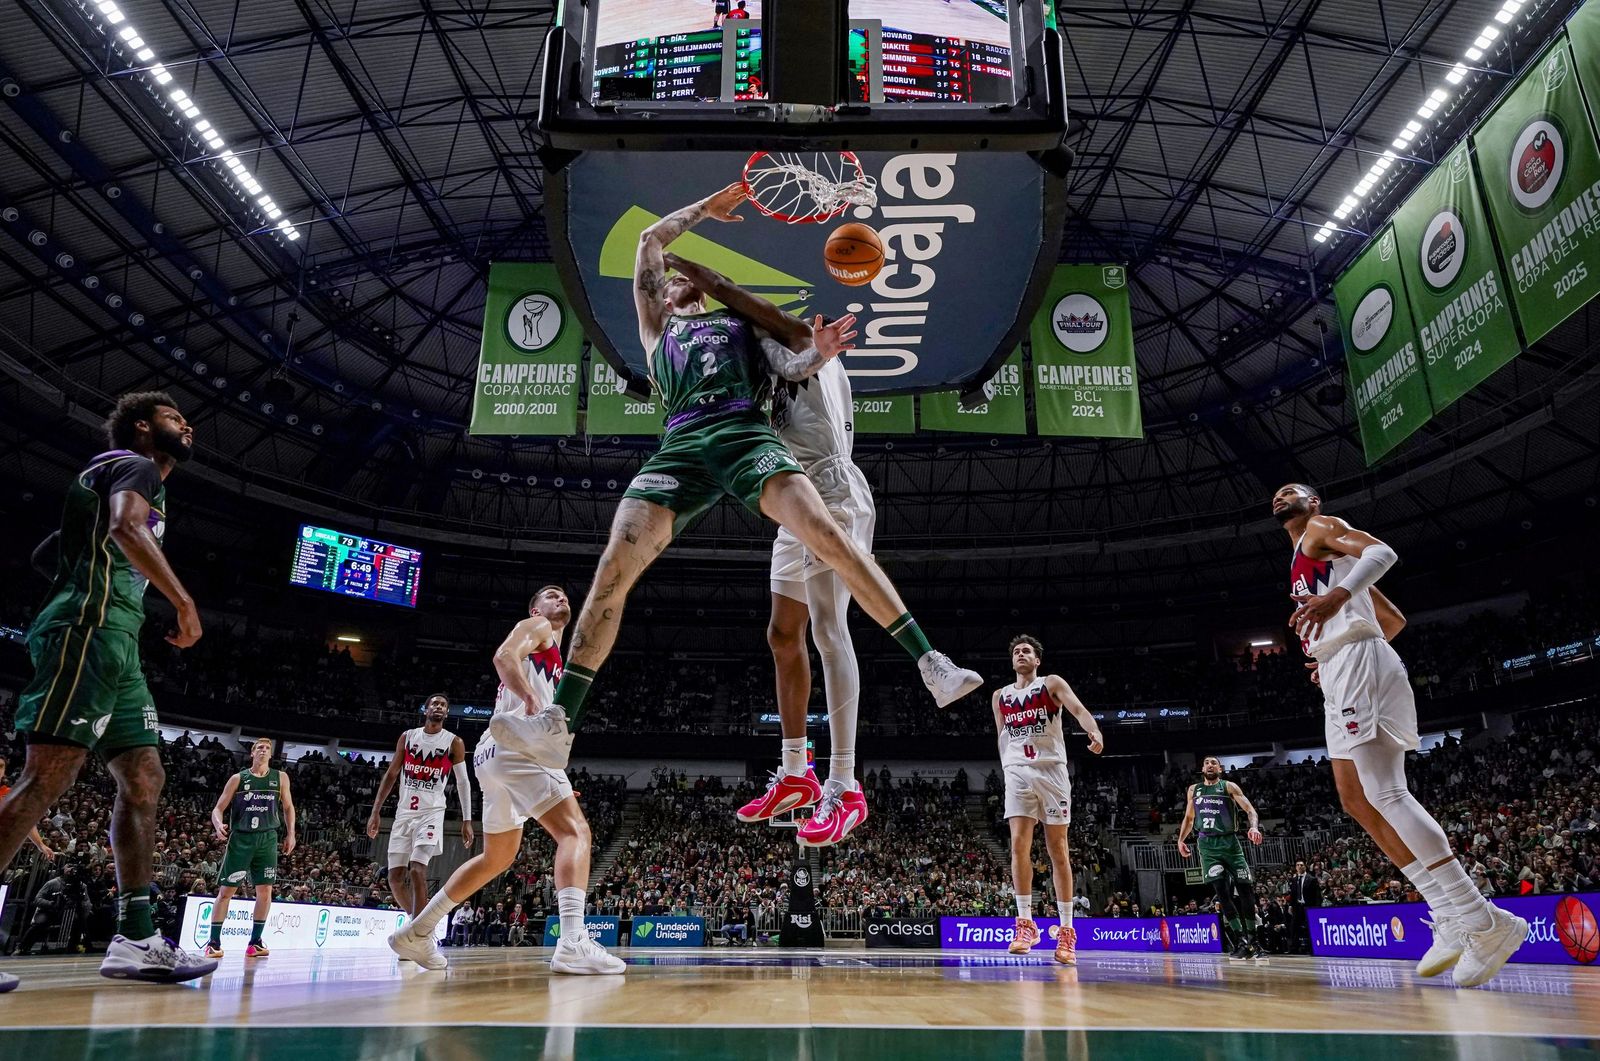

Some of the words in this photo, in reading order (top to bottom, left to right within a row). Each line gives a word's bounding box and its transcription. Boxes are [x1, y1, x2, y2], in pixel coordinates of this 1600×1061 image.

[882, 31, 912, 40] HOWARD
[673, 42, 723, 53] SULEJMANOVIC
[882, 43, 910, 51] DIAKITE
[673, 55, 695, 64] RUBIT
[882, 54, 917, 63] SIMMONS
[986, 56, 1002, 64] DIOP
[673, 66, 701, 75] DUARTE
[882, 65, 907, 73] VILLAR
[971, 64, 981, 72] 25
[986, 67, 1011, 77] FRISCH
[673, 78, 694, 86] TILLIE
[882, 76, 916, 85] OMORUYI
[656, 91, 666, 99] 55
[671, 89, 695, 97] PERRY
[1518, 261, 1550, 294] COPA
[1552, 237, 1580, 265] DEL
[1582, 213, 1600, 239] RE
[828, 264, 869, 279] Wilson
[846, 153, 976, 377] Unicaja
[1553, 261, 1588, 299] 2025
[1420, 269, 1498, 352] CAMPEONES
[691, 318, 739, 329] Unicaja
[1426, 295, 1504, 367] SUPERCOPA
[680, 333, 729, 351] málaga
[1453, 339, 1483, 371] 2024
[701, 352, 718, 377] 2
[480, 363, 577, 384] CAMPEONES
[1038, 365, 1133, 386] CAMPEONES
[1356, 342, 1416, 410] CAMPEONES
[483, 385, 520, 396] COPA
[524, 385, 570, 396] KORAC
[591, 385, 621, 396] COP
[994, 385, 1020, 396] REY
[1074, 391, 1101, 402] BCL
[493, 402, 558, 415] 2000/2001
[624, 403, 656, 415] 2005
[852, 401, 893, 414] 6/2017
[957, 402, 989, 414] 223
[1071, 405, 1104, 417] 2024
[1381, 402, 1404, 430] 2024
[342, 537, 354, 546] 79
[358, 540, 369, 549] VS
[373, 544, 385, 553] 74
[351, 562, 371, 573] 6:49
[1005, 705, 1047, 724] kingroyal
[1008, 724, 1047, 738] kosner
[1024, 744, 1036, 759] 4
[410, 796, 419, 811] 2
[1202, 817, 1215, 829] 27
[790, 914, 811, 924] Risi
[237, 927, 252, 936] GRADU
[584, 921, 615, 931] dación
[655, 922, 700, 931] Fundación
[868, 922, 934, 937] endesa
[956, 923, 1044, 942] Transar
[1319, 917, 1388, 947] Transaher
[1524, 916, 1560, 944] stic
[655, 931, 688, 940] Unicaja
[1092, 927, 1140, 941] Smart
[1174, 922, 1210, 944] Transaher
